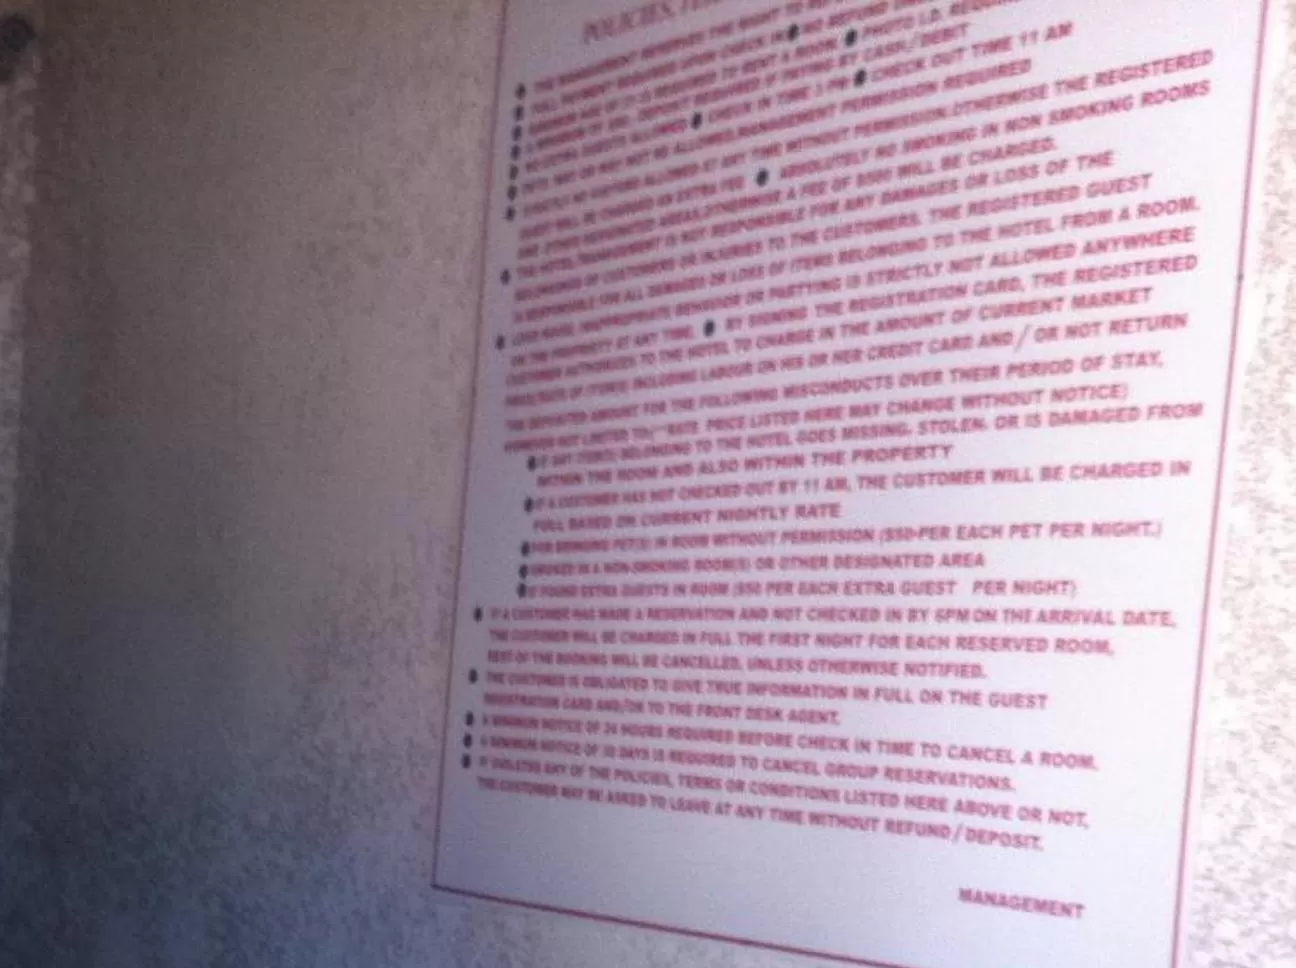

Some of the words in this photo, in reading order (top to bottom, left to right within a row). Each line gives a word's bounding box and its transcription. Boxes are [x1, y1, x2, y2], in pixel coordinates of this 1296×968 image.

[1044, 21, 1073, 41] AM
[1094, 48, 1214, 86] REGISTERED
[1048, 94, 1134, 125] SMOKING
[1139, 79, 1211, 107] ROOMS
[1045, 158, 1068, 176] OF
[1077, 150, 1116, 170] THE
[1085, 173, 1152, 197] GUEST
[1061, 208, 1113, 229] FROM
[988, 242, 1077, 267] ALLOWED
[1082, 226, 1196, 255] ANYWHERE
[1031, 270, 1068, 288] THE
[1073, 254, 1198, 283] REGISTERED
[1071, 287, 1153, 309] MARKET
[1033, 325, 1059, 341] OR
[1065, 321, 1102, 338] NOT
[1108, 312, 1188, 334] RETURN
[1006, 357, 1073, 377] PERIOD
[1080, 355, 1105, 371] OF
[994, 414, 1019, 429] OR
[1025, 413, 1042, 427] IS
[1048, 406, 1141, 426] DAMAGED
[1146, 402, 1203, 420] FROM
[851, 442, 954, 462] PROPERTY
[892, 469, 985, 487] CUSTOMER
[991, 467, 1033, 482] WILL
[1039, 465, 1065, 480] BE
[1069, 461, 1162, 479] CHARGED
[1169, 460, 1191, 476] IN
[956, 524, 1003, 538] EACH
[1009, 523, 1043, 537] PET
[1049, 522, 1085, 536] PER
[939, 553, 985, 567] AREA
[972, 580, 1007, 593] PER
[1036, 609, 1116, 625] ARRIVAL
[904, 634, 949, 648] EACH
[955, 635, 1049, 652] RESERVED
[948, 690, 981, 705] THE
[988, 692, 1048, 708] GUEST
[947, 744, 1013, 763] CANCEL
[953, 799, 1013, 818] ABOVE
[1017, 805, 1042, 822] OR
[958, 887, 1085, 919] MANAGEMENT
